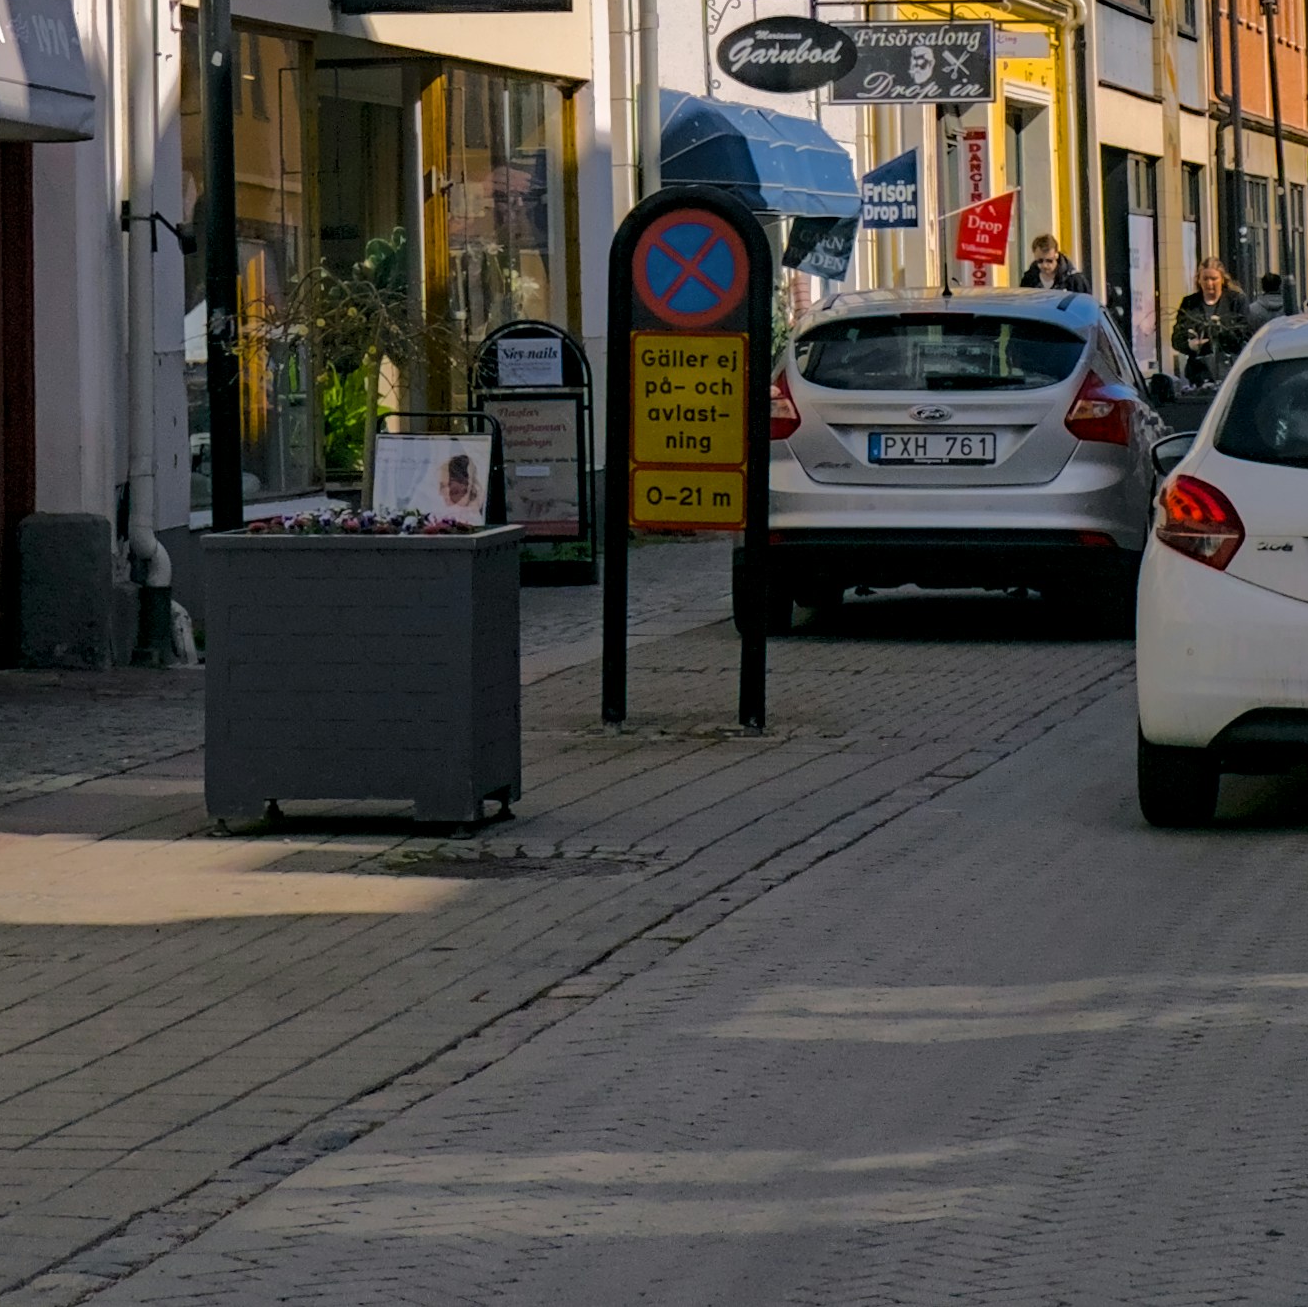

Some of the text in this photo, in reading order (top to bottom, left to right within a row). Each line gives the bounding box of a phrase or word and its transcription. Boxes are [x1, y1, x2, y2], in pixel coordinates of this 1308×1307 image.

[853, 26, 982, 53] Frisörsalong
[728, 37, 843, 72] Garnbod
[857, 72, 985, 105] Drop in
[967, 143, 986, 203] DANCIN
[863, 180, 916, 202] Frisör
[863, 203, 917, 222] Drop in
[967, 214, 1003, 234] Drop
[975, 229, 990, 244] in
[526, 346, 558, 361] nails
[641, 349, 738, 372] Gäller ej
[645, 377, 733, 398] på- och
[648, 404, 730, 422] avlast-
[666, 431, 712, 453] ning
[884, 436, 987, 457] PXH 761
[646, 486, 731, 507] 0-21 m
